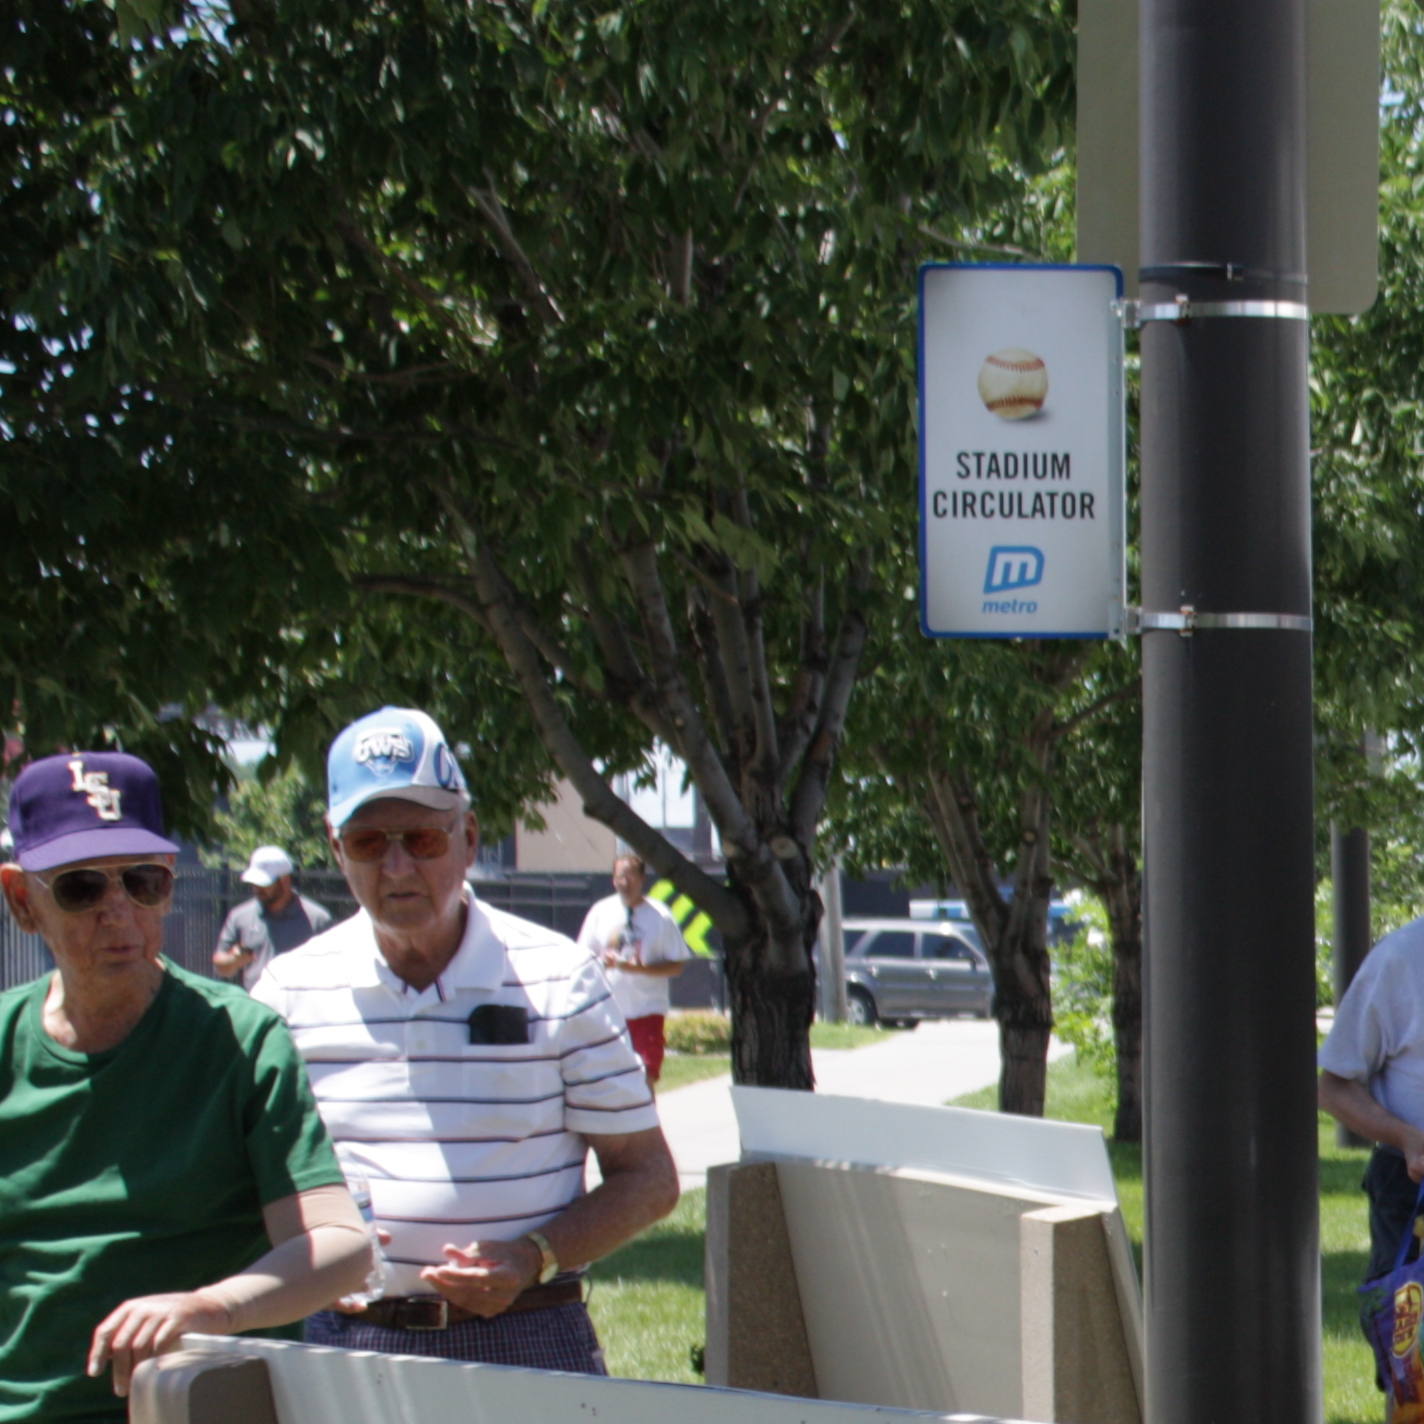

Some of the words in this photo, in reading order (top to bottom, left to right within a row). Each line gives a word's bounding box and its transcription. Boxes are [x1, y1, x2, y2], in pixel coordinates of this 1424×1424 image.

[956, 452, 1071, 481] STADIUM
[933, 491, 1096, 519] CIRCULATOR
[982, 599, 1038, 614] metro
[68, 760, 123, 821] LSU
